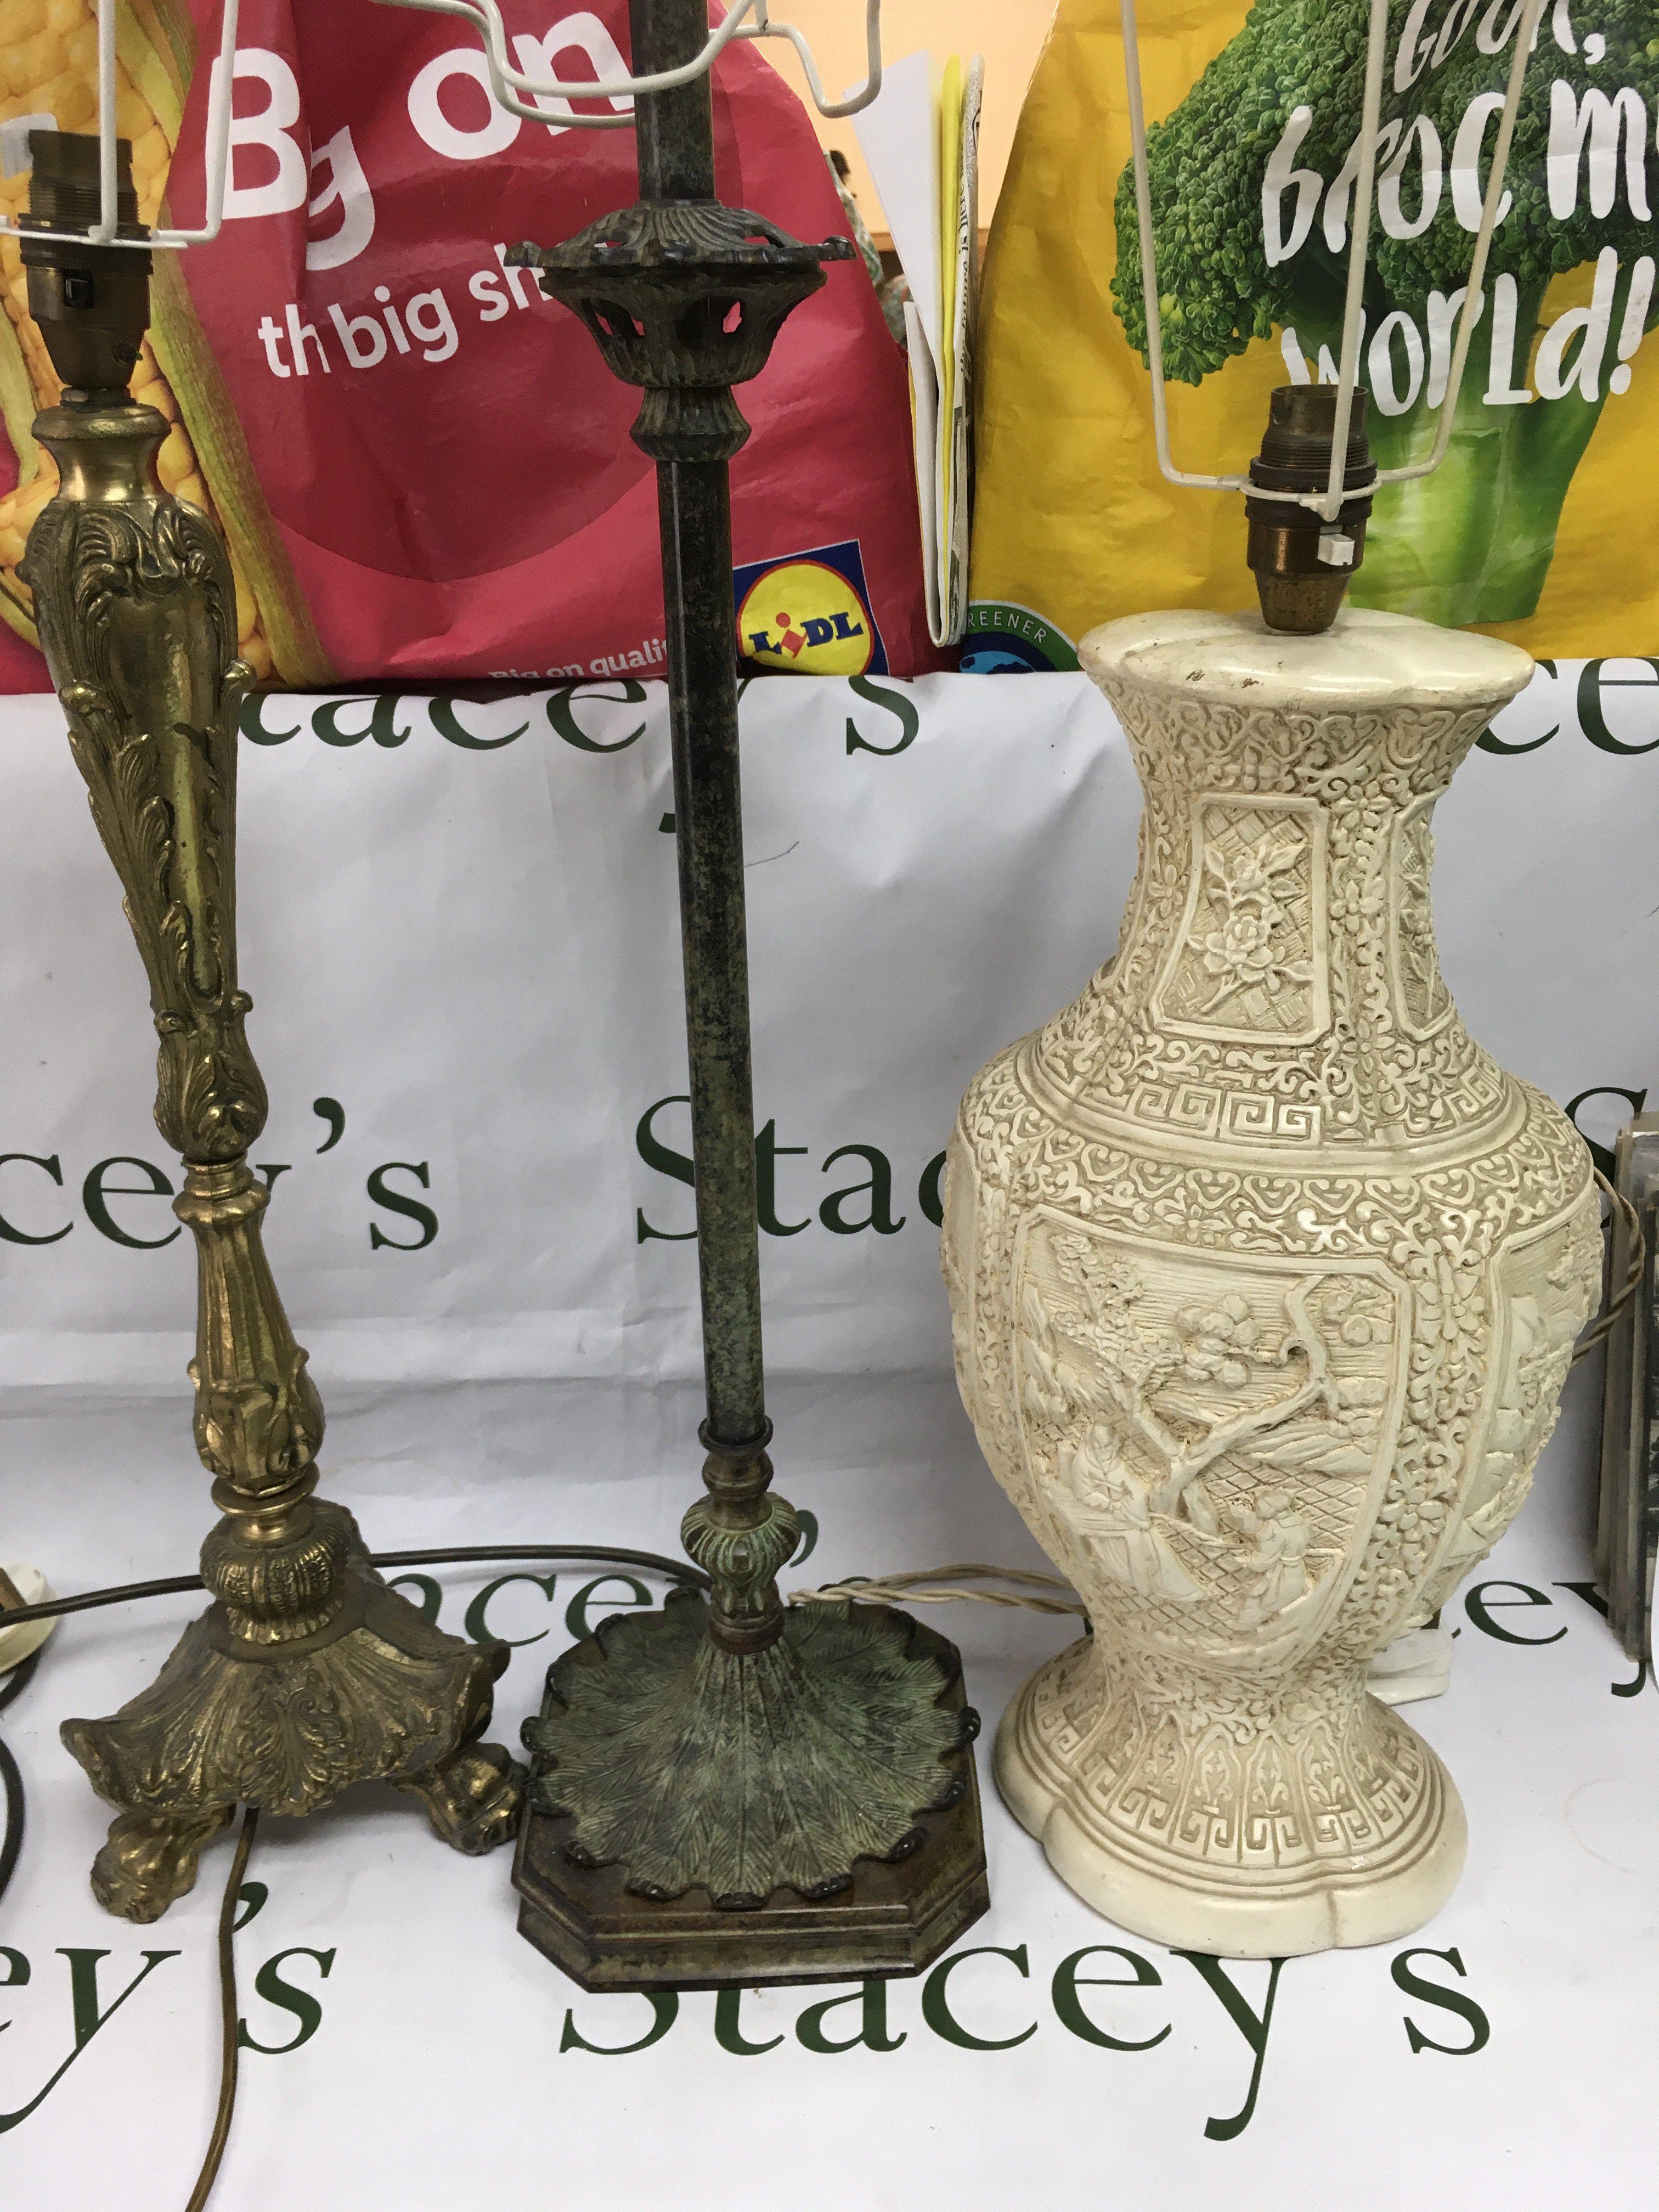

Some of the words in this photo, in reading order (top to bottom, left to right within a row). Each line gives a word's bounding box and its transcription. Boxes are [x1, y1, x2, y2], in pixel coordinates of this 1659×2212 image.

[206, 47, 375, 271] Bg
[408, 12, 634, 160] on
[1262, 105, 1513, 267] broc
[1547, 79, 1659, 222] m
[257, 303, 331, 377] th
[328, 285, 459, 368] big
[469, 242, 554, 321] sh
[590, 638, 667, 676] quali
[967, 611, 1047, 644] REENER
